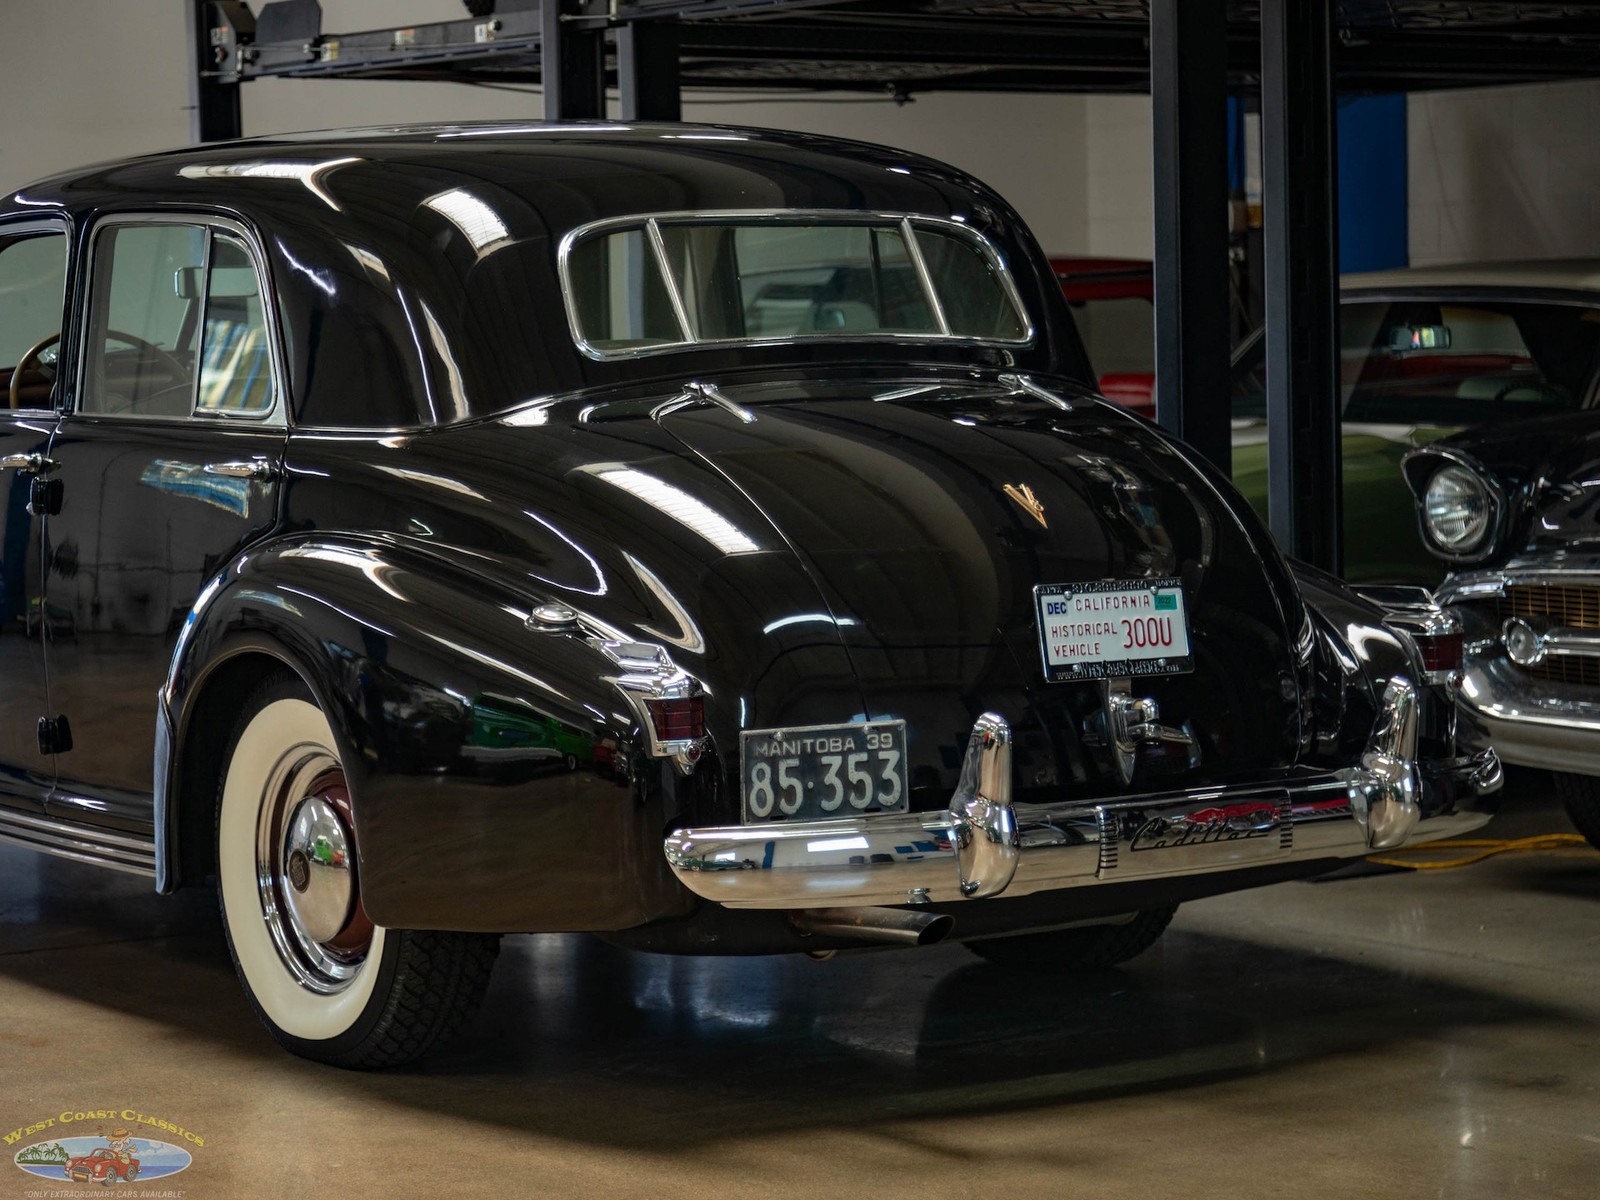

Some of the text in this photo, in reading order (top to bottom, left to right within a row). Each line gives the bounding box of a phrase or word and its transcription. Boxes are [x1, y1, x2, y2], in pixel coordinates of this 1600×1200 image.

[1047, 602, 1067, 615] DEC
[1075, 594, 1150, 612] CALIFORNIA
[1051, 622, 1118, 638] HISTORICAL
[1121, 617, 1173, 649] 300U
[1054, 642, 1101, 658] VEHICLE
[754, 732, 893, 758] MANITOBA 39
[1130, 816, 1269, 852] Cadillac
